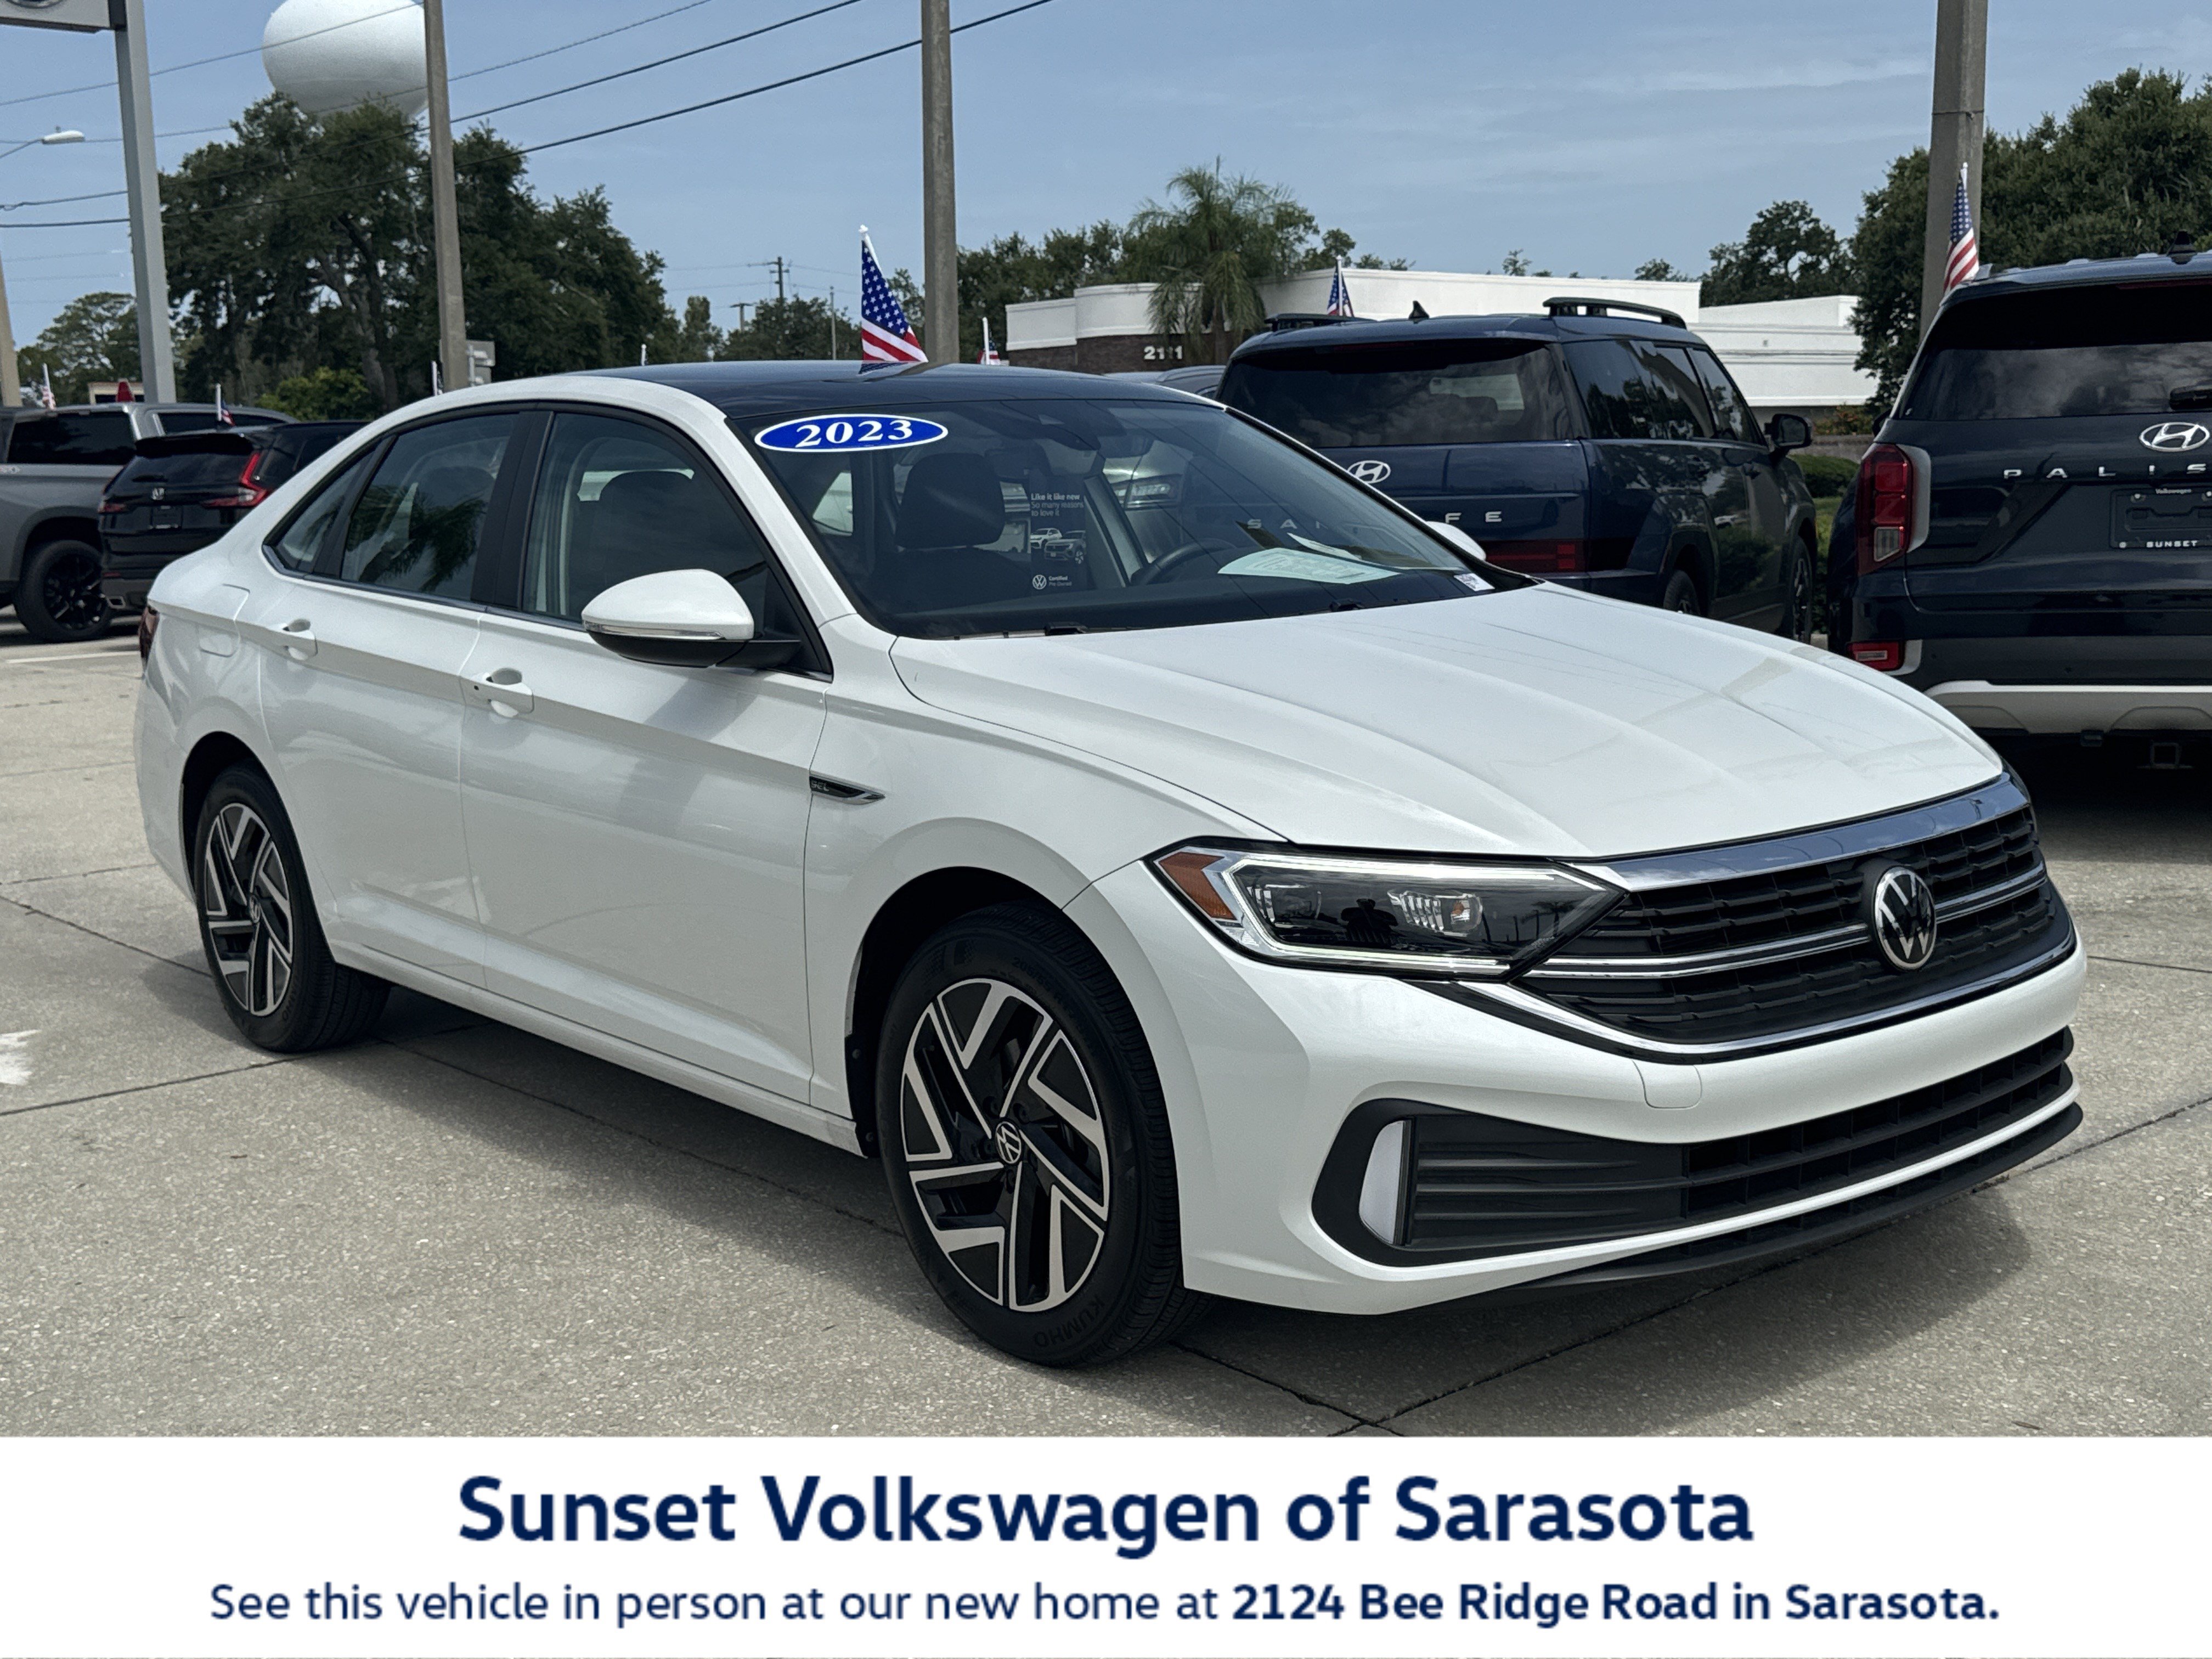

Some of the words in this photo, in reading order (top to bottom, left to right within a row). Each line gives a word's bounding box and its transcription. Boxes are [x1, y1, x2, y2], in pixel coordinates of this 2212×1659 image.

[795, 420, 913, 448] 2023
[811, 780, 830, 791] SEL
[1032, 1295, 1105, 1347] KUMHO
